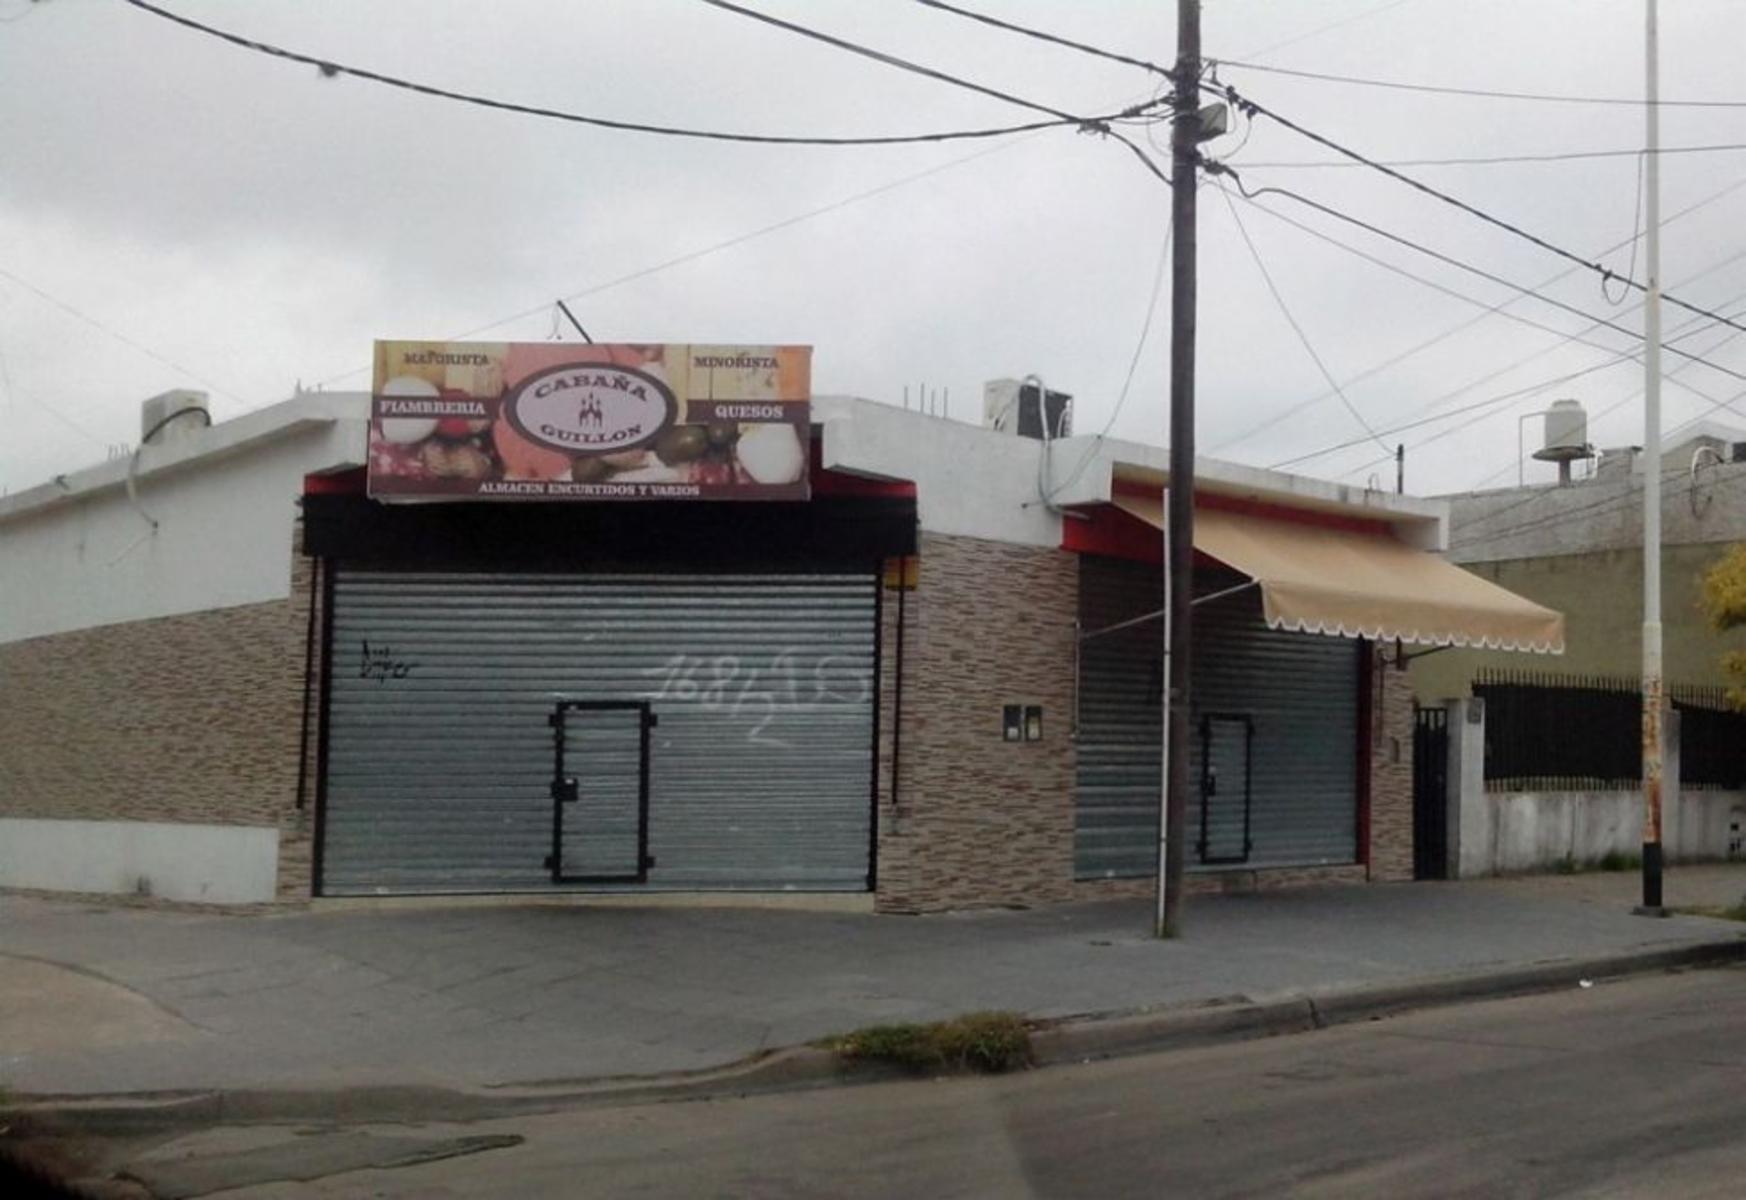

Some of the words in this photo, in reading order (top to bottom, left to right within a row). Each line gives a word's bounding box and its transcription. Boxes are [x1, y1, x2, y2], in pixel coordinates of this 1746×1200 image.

[694, 355, 779, 369] MINORISTA
[534, 375, 647, 402] CABAÑA
[715, 404, 784, 419] QUESOS
[479, 482, 545, 494] ALMACEN
[548, 483, 635, 496] ENCURTIDOS
[638, 485, 648, 496] Y
[650, 485, 700, 497] VARIOS
